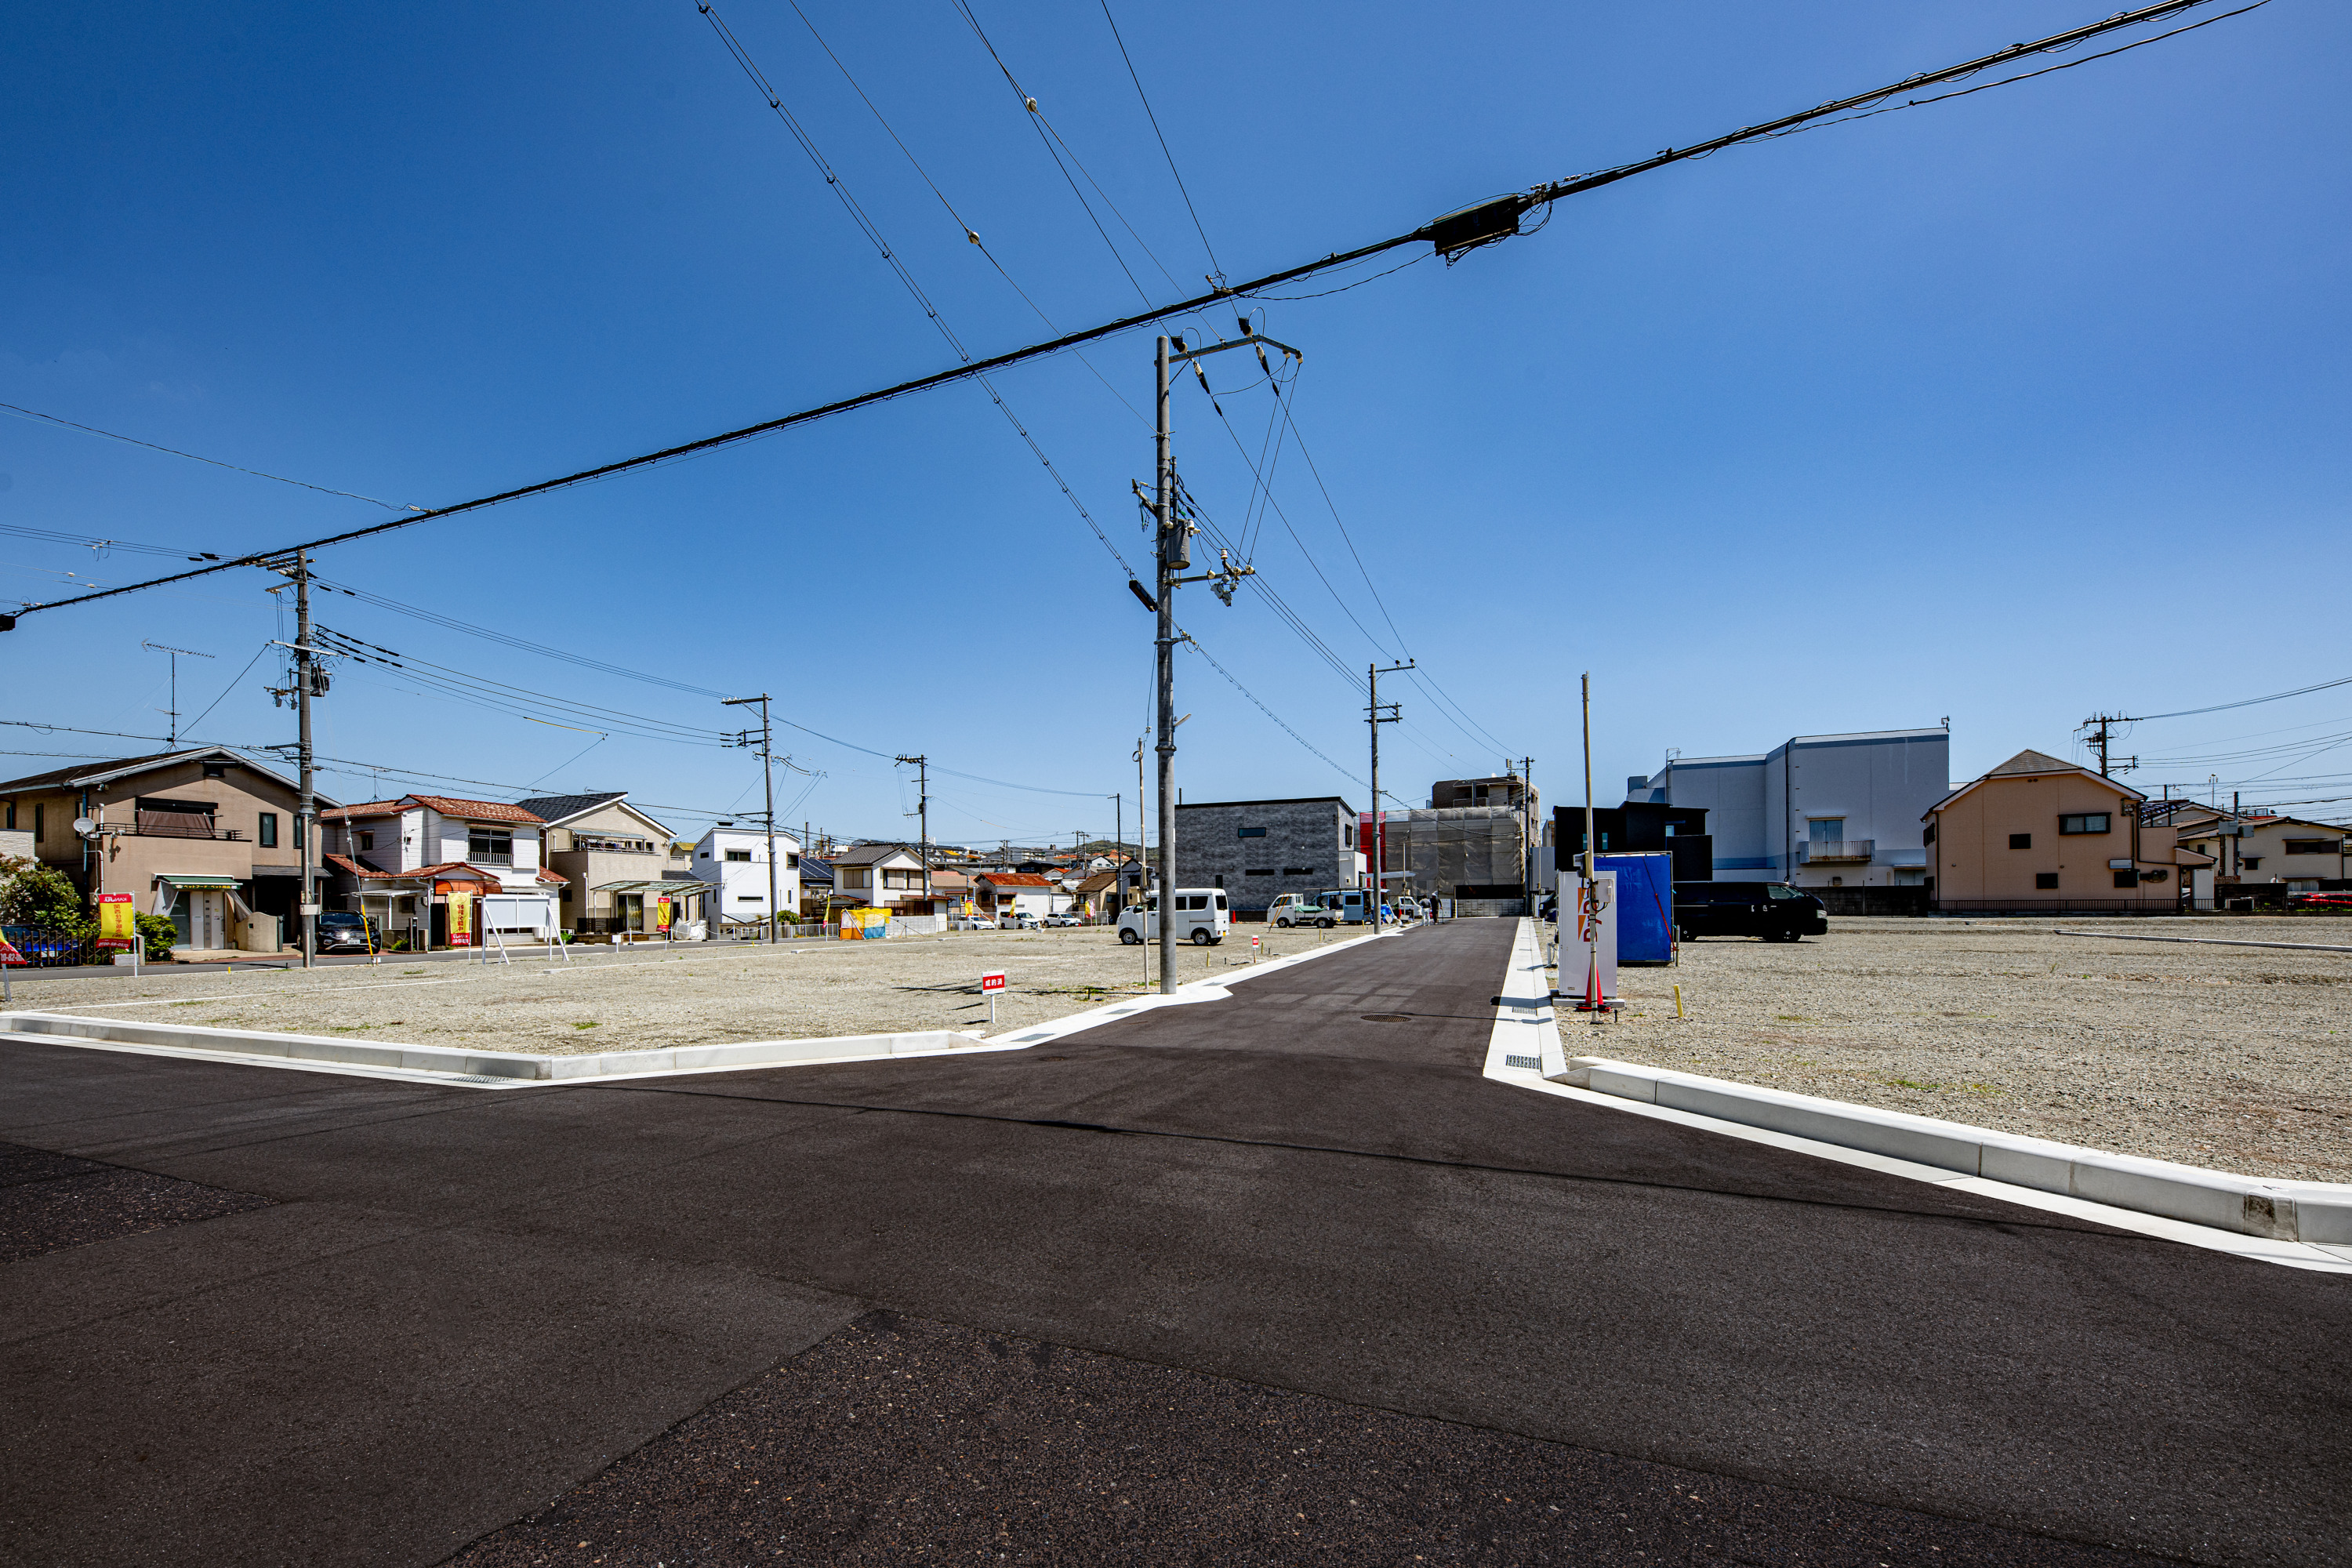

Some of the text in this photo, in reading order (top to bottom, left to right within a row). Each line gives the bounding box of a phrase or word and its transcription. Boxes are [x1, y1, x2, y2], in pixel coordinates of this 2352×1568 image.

[1584, 887, 1602, 942] DyD
[985, 978, 1003, 987] 成約済
